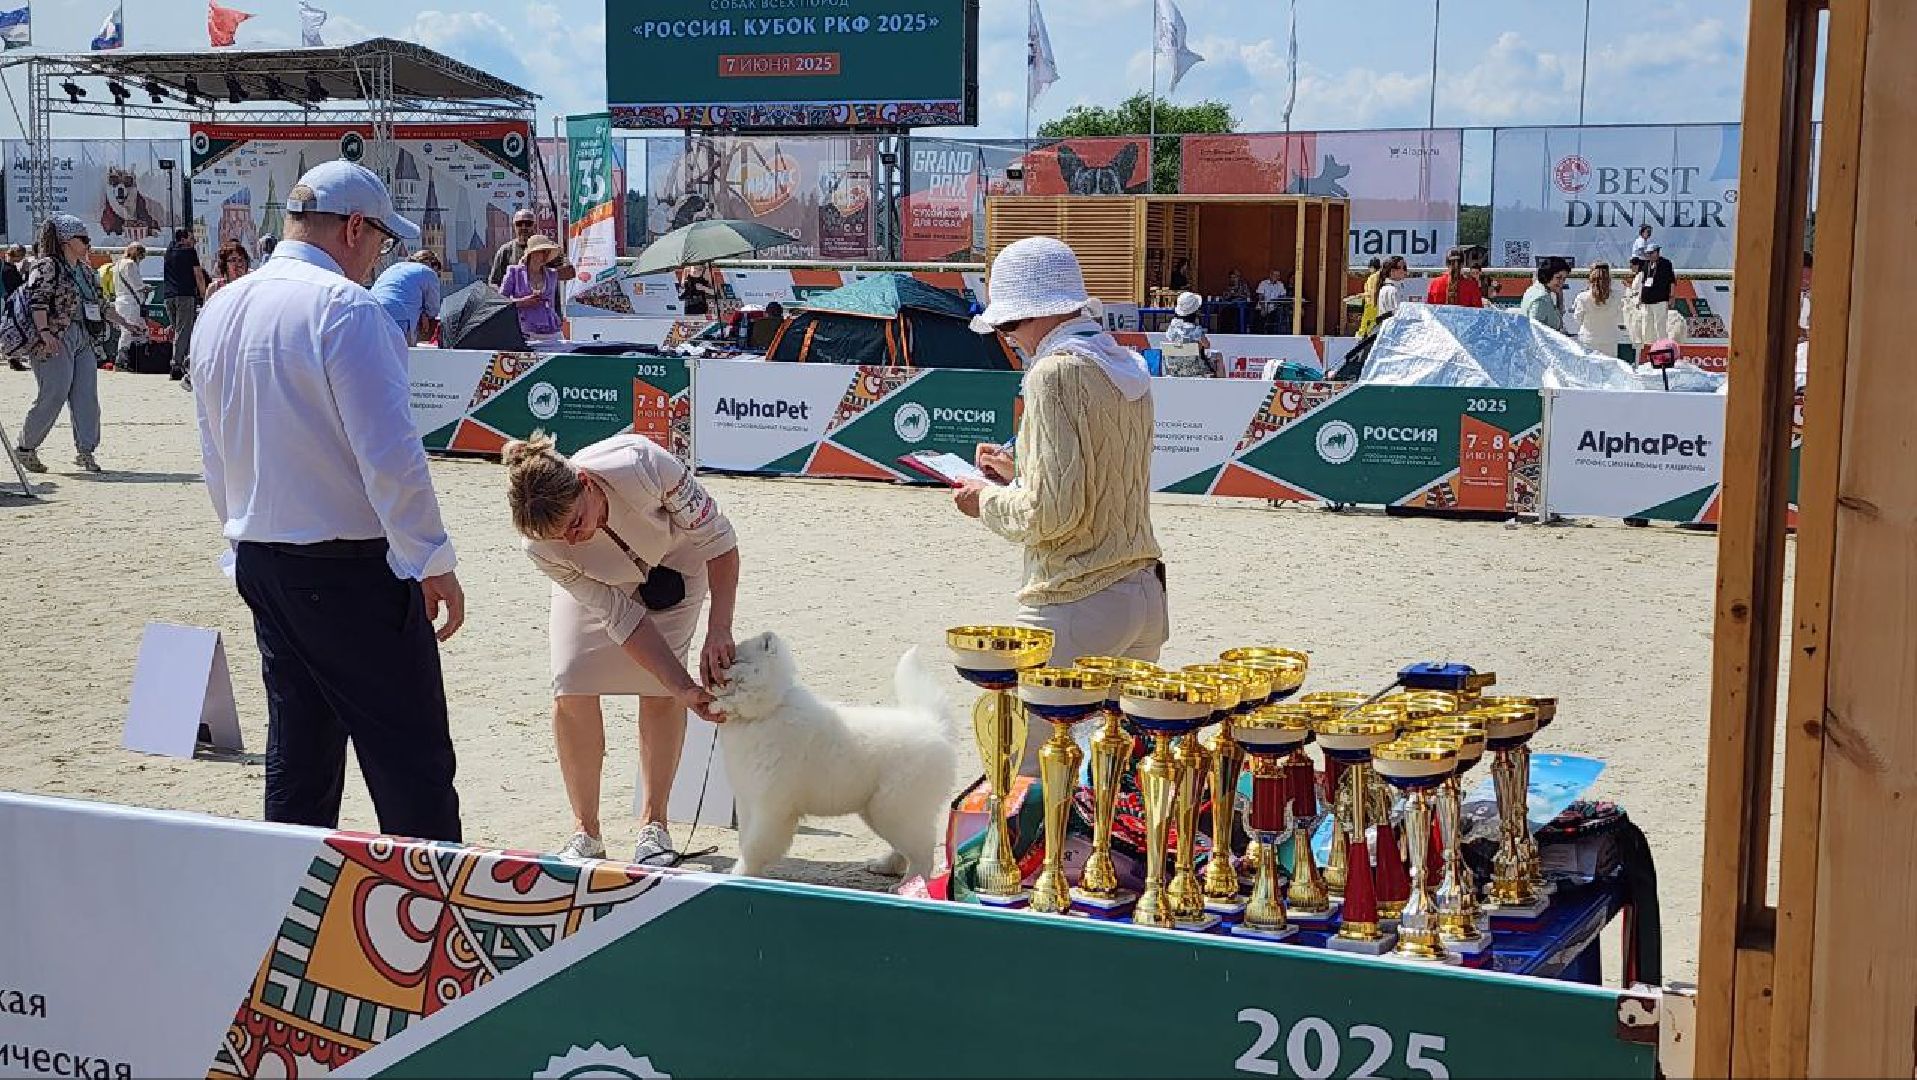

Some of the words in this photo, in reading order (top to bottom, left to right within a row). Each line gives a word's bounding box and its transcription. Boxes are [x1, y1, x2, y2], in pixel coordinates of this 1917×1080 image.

[710, 0, 757, 10] СОБАК
[761, 0, 796, 9] ВСЕХ
[632, 20, 738, 38] «РОССИЯ.
[744, 17, 817, 36] КУБОК
[824, 15, 871, 34] РКФ
[878, 13, 940, 33] 2025»
[727, 58, 736, 72] 7
[740, 57, 791, 72] ИЮНЯ
[795, 56, 832, 71] 2025
[912, 150, 973, 173] GRAND
[929, 174, 969, 197] PRIX
[1596, 166, 1700, 195] BEST
[1564, 199, 1727, 228] DINNER
[637, 364, 667, 376] 2025
[562, 386, 618, 402] РОССИЯ
[714, 397, 809, 421] AlphaPet
[1466, 398, 1507, 412] 2025
[933, 407, 996, 424] РОССИЯ
[1363, 425, 1438, 442] РОССИЯ
[1576, 429, 1709, 459] AlphaPet
[1465, 452, 1504, 462] ИЮНЯ
[1234, 1007, 1450, 1079] 2025
